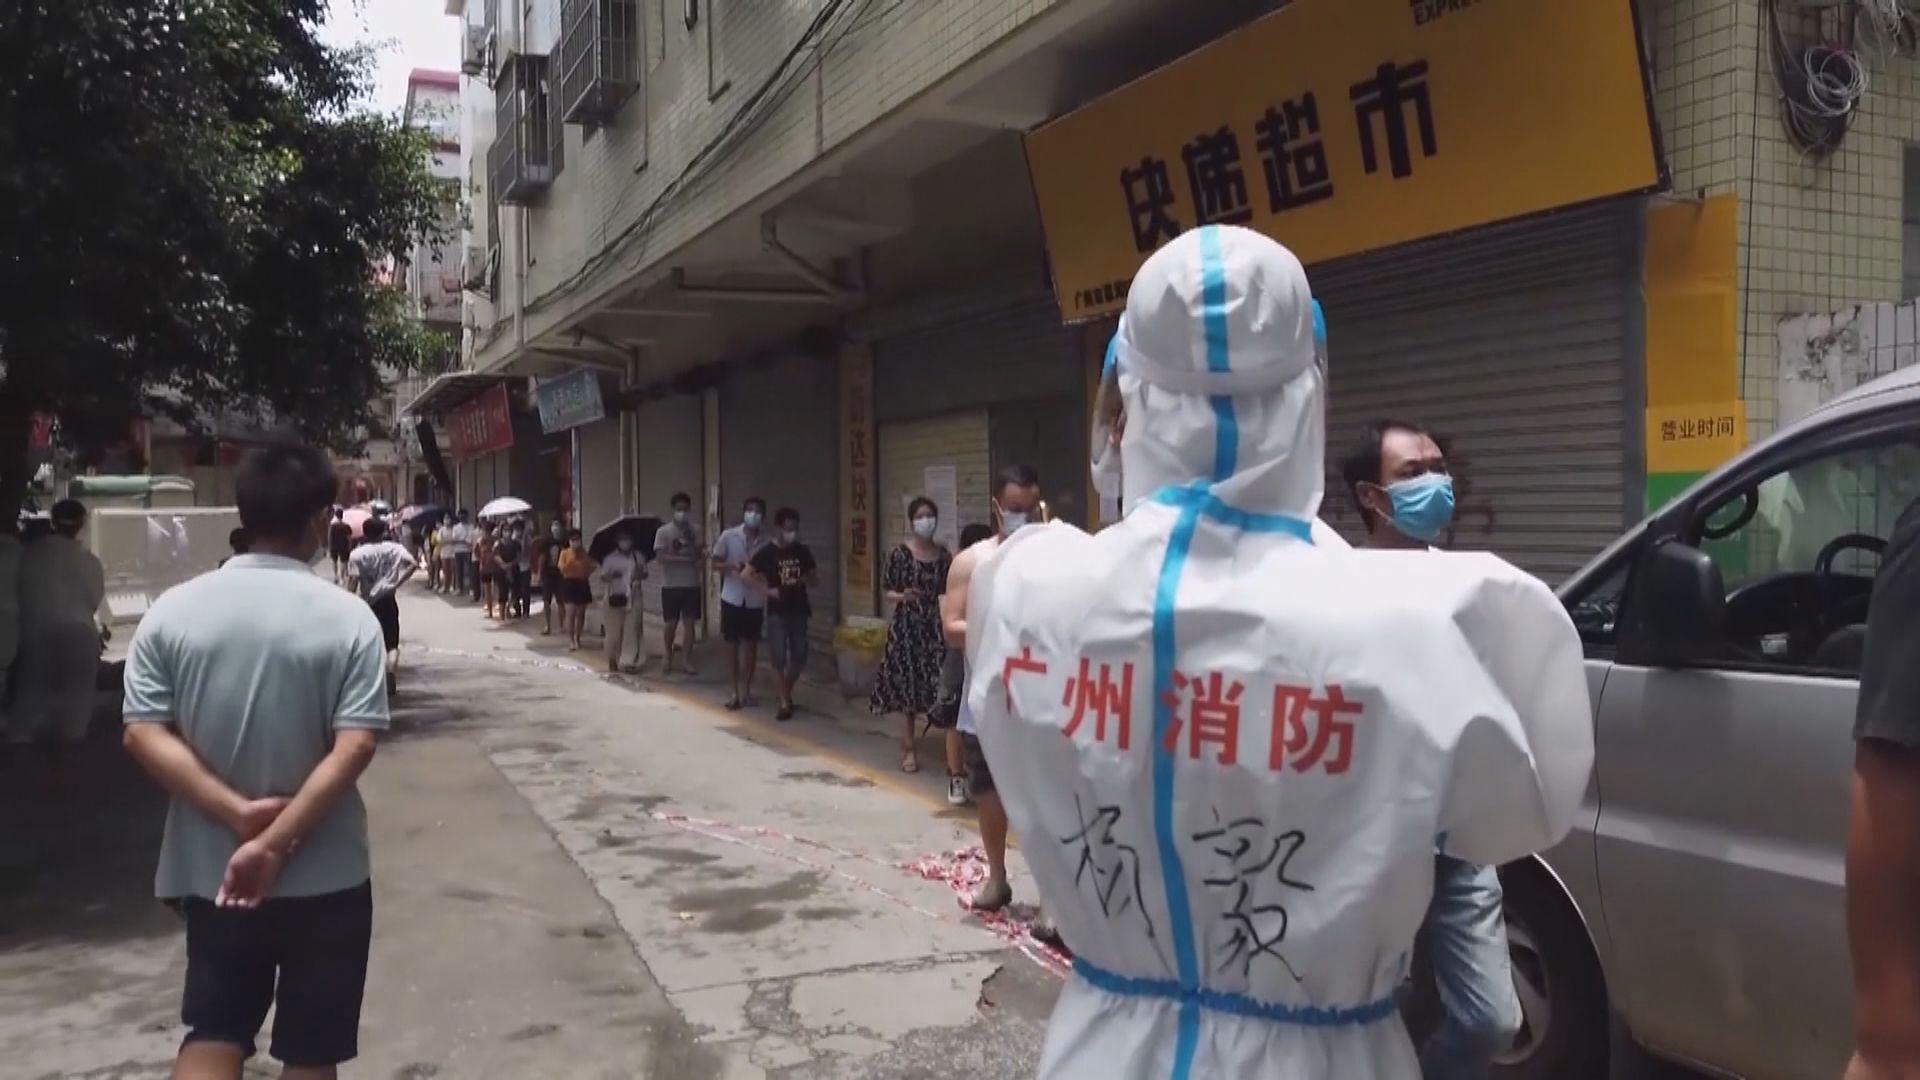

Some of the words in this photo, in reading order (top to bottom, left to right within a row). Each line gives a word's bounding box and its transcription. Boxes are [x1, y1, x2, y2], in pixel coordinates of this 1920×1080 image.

[1119, 58, 1438, 254] 快递超市
[1660, 416, 1735, 441] 营业时间
[1002, 646, 1364, 776] 广州消防
